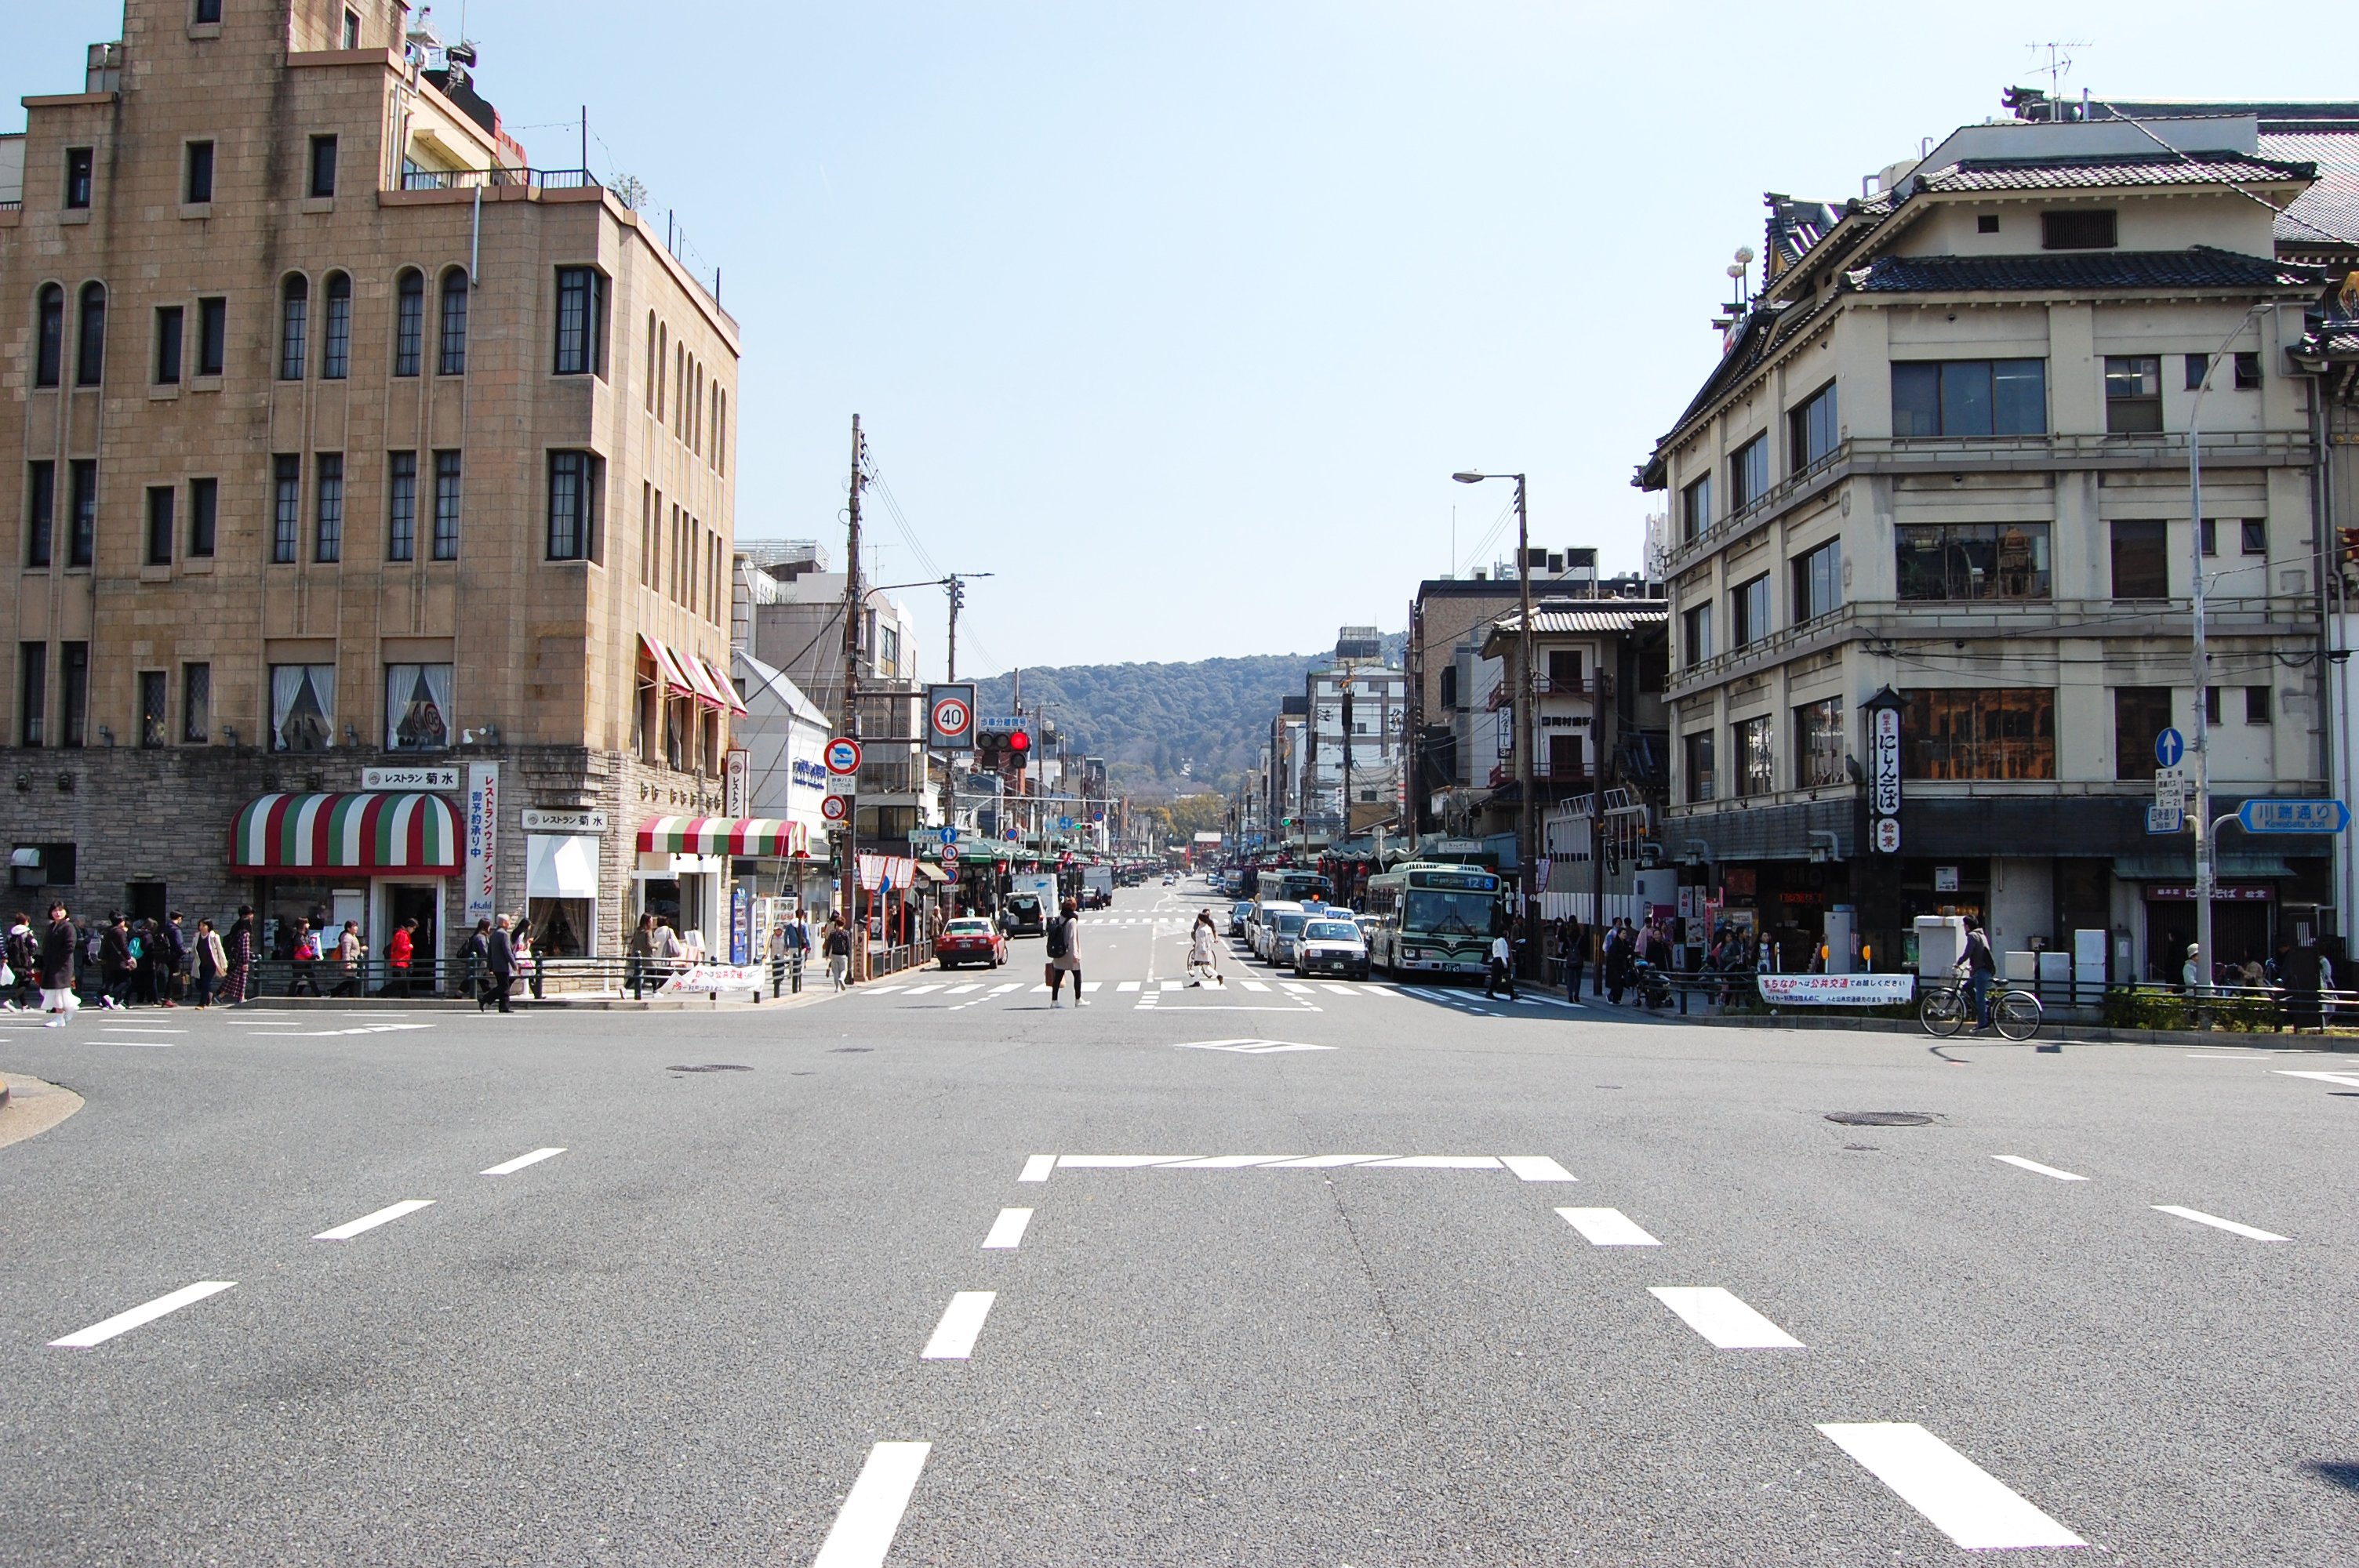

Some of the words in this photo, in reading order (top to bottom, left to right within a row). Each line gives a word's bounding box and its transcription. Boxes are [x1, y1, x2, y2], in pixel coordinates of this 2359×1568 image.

[941, 709, 961, 725] 40
[385, 773, 423, 784] レストラン
[426, 771, 453, 785] 菊水
[1879, 735, 1897, 809] にしんそば
[732, 776, 740, 811] レストラン
[2259, 804, 2330, 819] 川端通り
[471, 791, 482, 858] 御予約承り中
[579, 815, 603, 826] 菊水
[483, 775, 494, 896] レストランウェディング
[1881, 822, 1895, 848] 松葉
[1467, 877, 1479, 888] 12
[2185, 888, 2237, 898] にそば
[470, 901, 492, 909] Asahi
